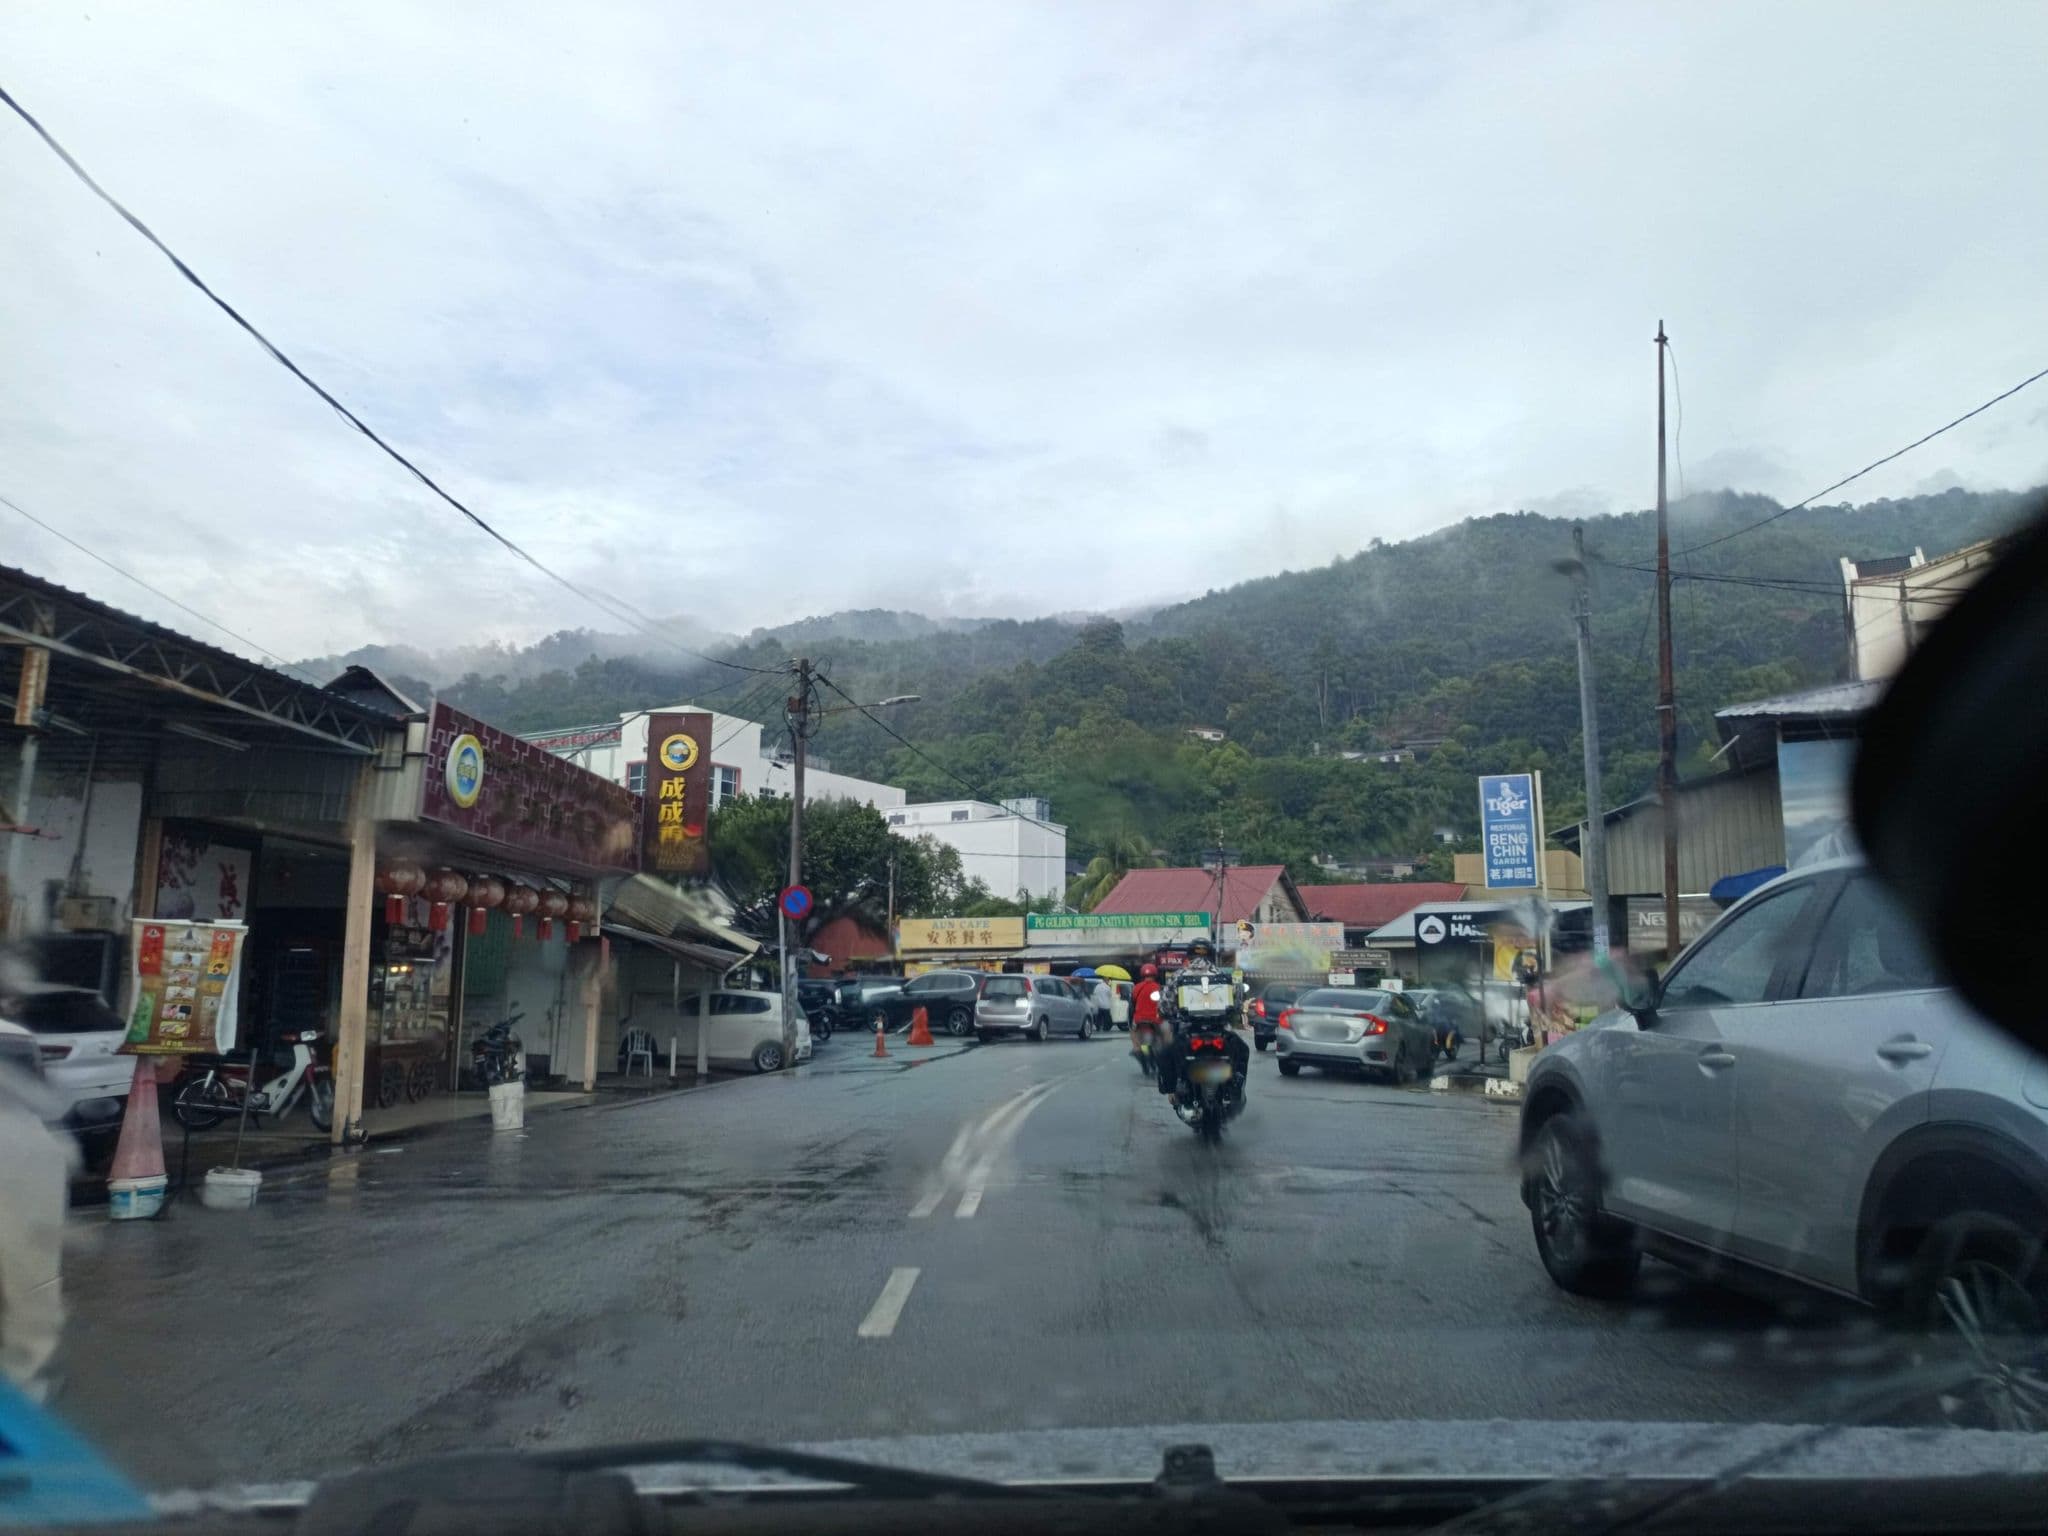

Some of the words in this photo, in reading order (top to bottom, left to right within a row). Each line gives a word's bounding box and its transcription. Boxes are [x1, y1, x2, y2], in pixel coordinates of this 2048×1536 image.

[1487, 797, 1528, 816] Tiger
[1490, 833, 1528, 846] BENG
[1493, 845, 1527, 857] CHIN
[1493, 857, 1528, 865] GARDEN
[1045, 916, 1073, 928] GOLDEN
[1073, 916, 1100, 928] ORCHID
